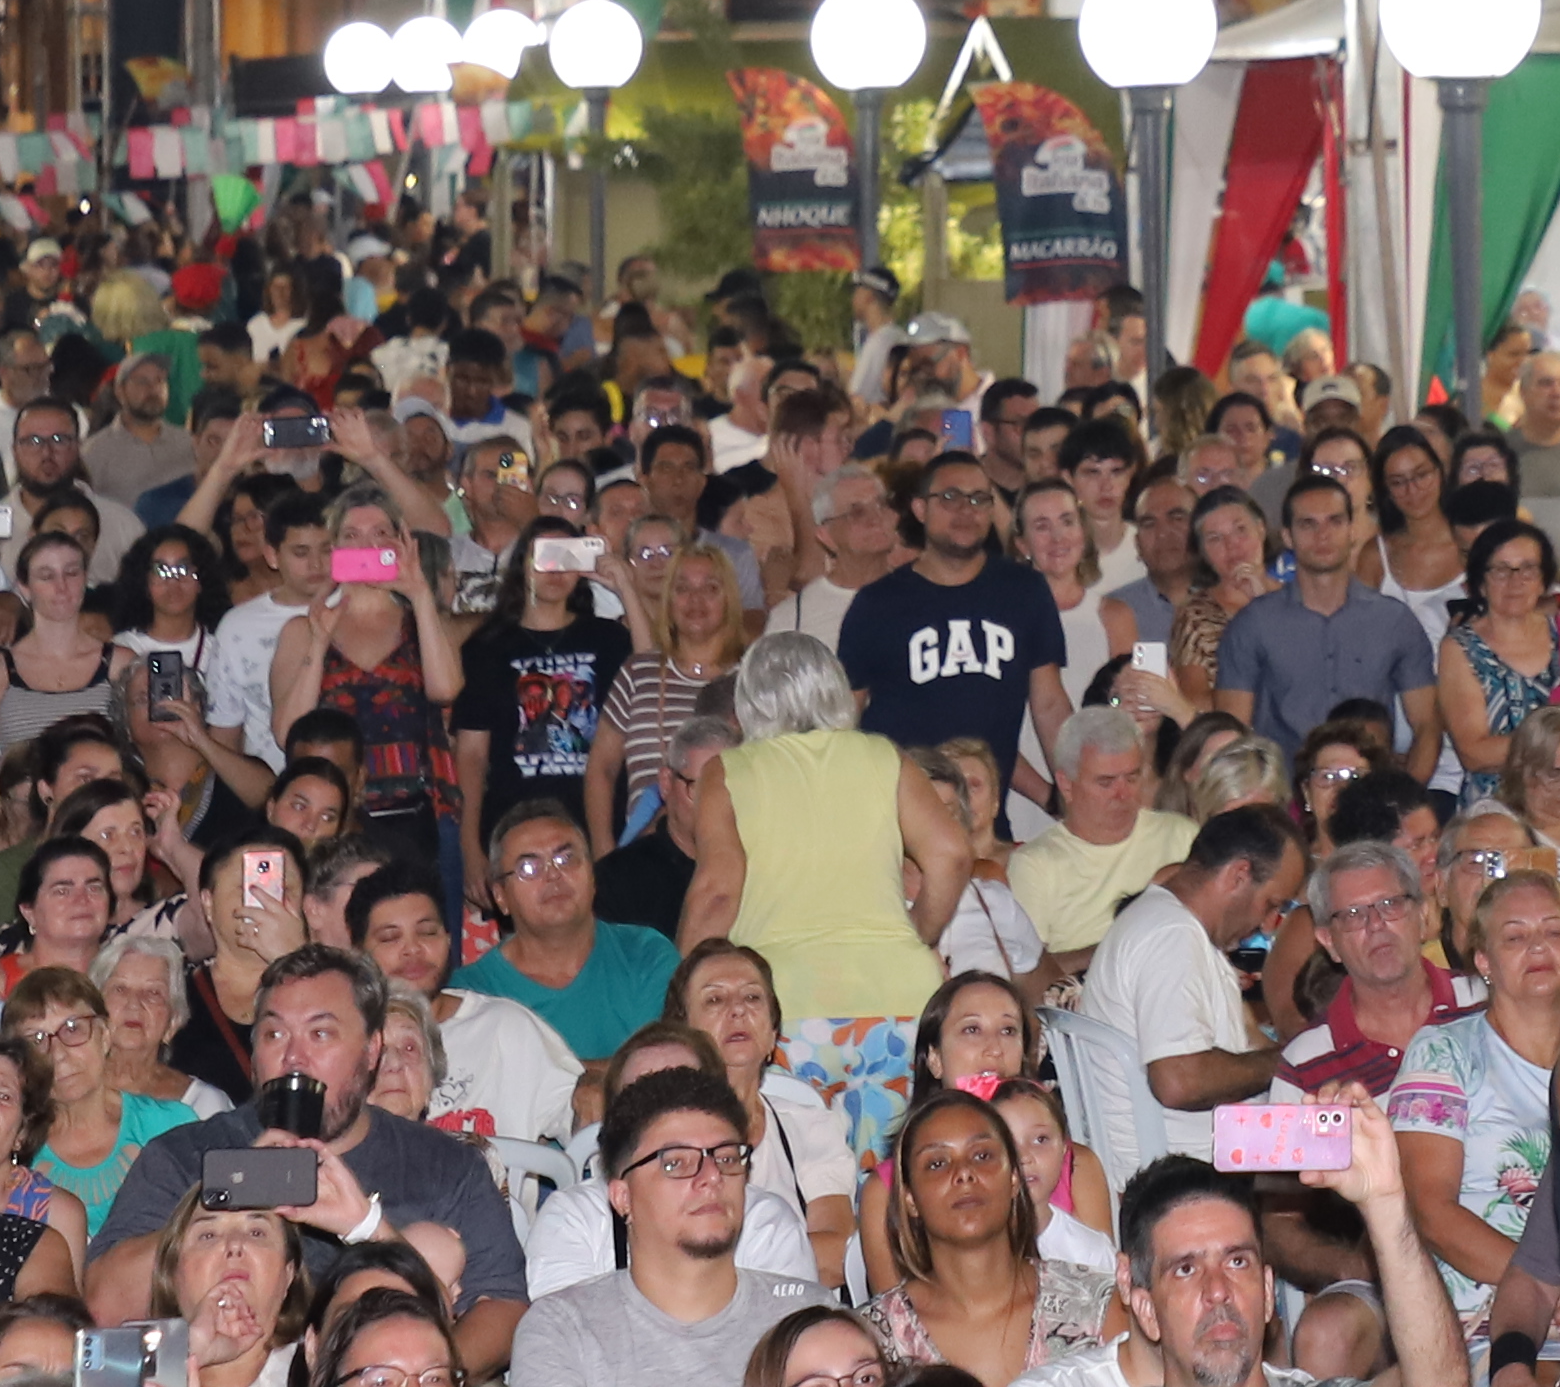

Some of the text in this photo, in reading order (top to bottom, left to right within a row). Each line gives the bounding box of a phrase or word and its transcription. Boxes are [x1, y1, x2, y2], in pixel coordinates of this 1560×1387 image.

[757, 204, 850, 228] NHOQUE
[1009, 237, 1118, 262] MACARRÃO
[908, 619, 1015, 685] GAP
[772, 1283, 805, 1297] AERO
